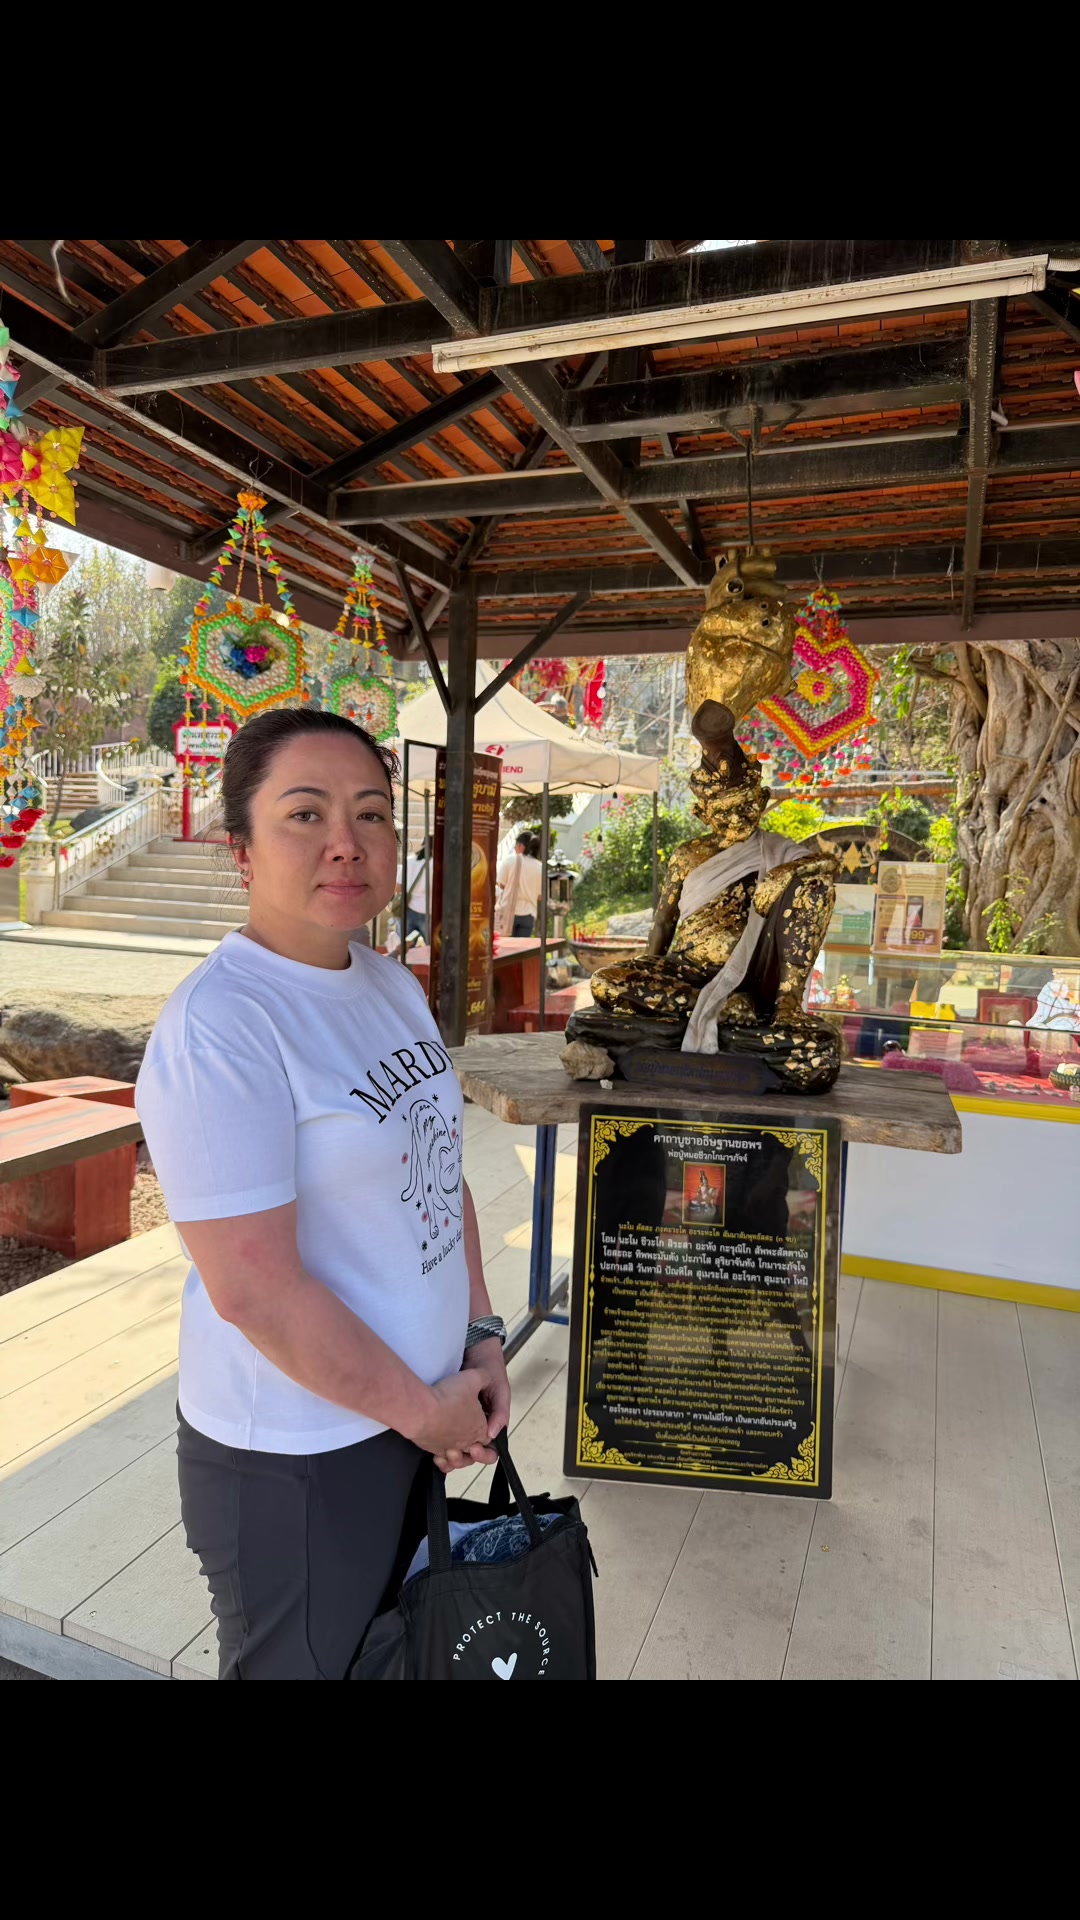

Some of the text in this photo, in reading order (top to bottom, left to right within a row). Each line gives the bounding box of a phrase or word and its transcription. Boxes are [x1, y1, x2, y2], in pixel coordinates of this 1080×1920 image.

[502, 765, 524, 774] IEND
[653, 1134, 762, 1150] คาถาบูชาอธิษฐานขอพร
[601, 1232, 616, 1243] โอม
[619, 1234, 638, 1245] นะโม
[641, 1236, 665, 1247] ชีวะโก
[421, 1260, 438, 1275] Have
[453, 1611, 550, 1675] PROTECT THE SOURCE
